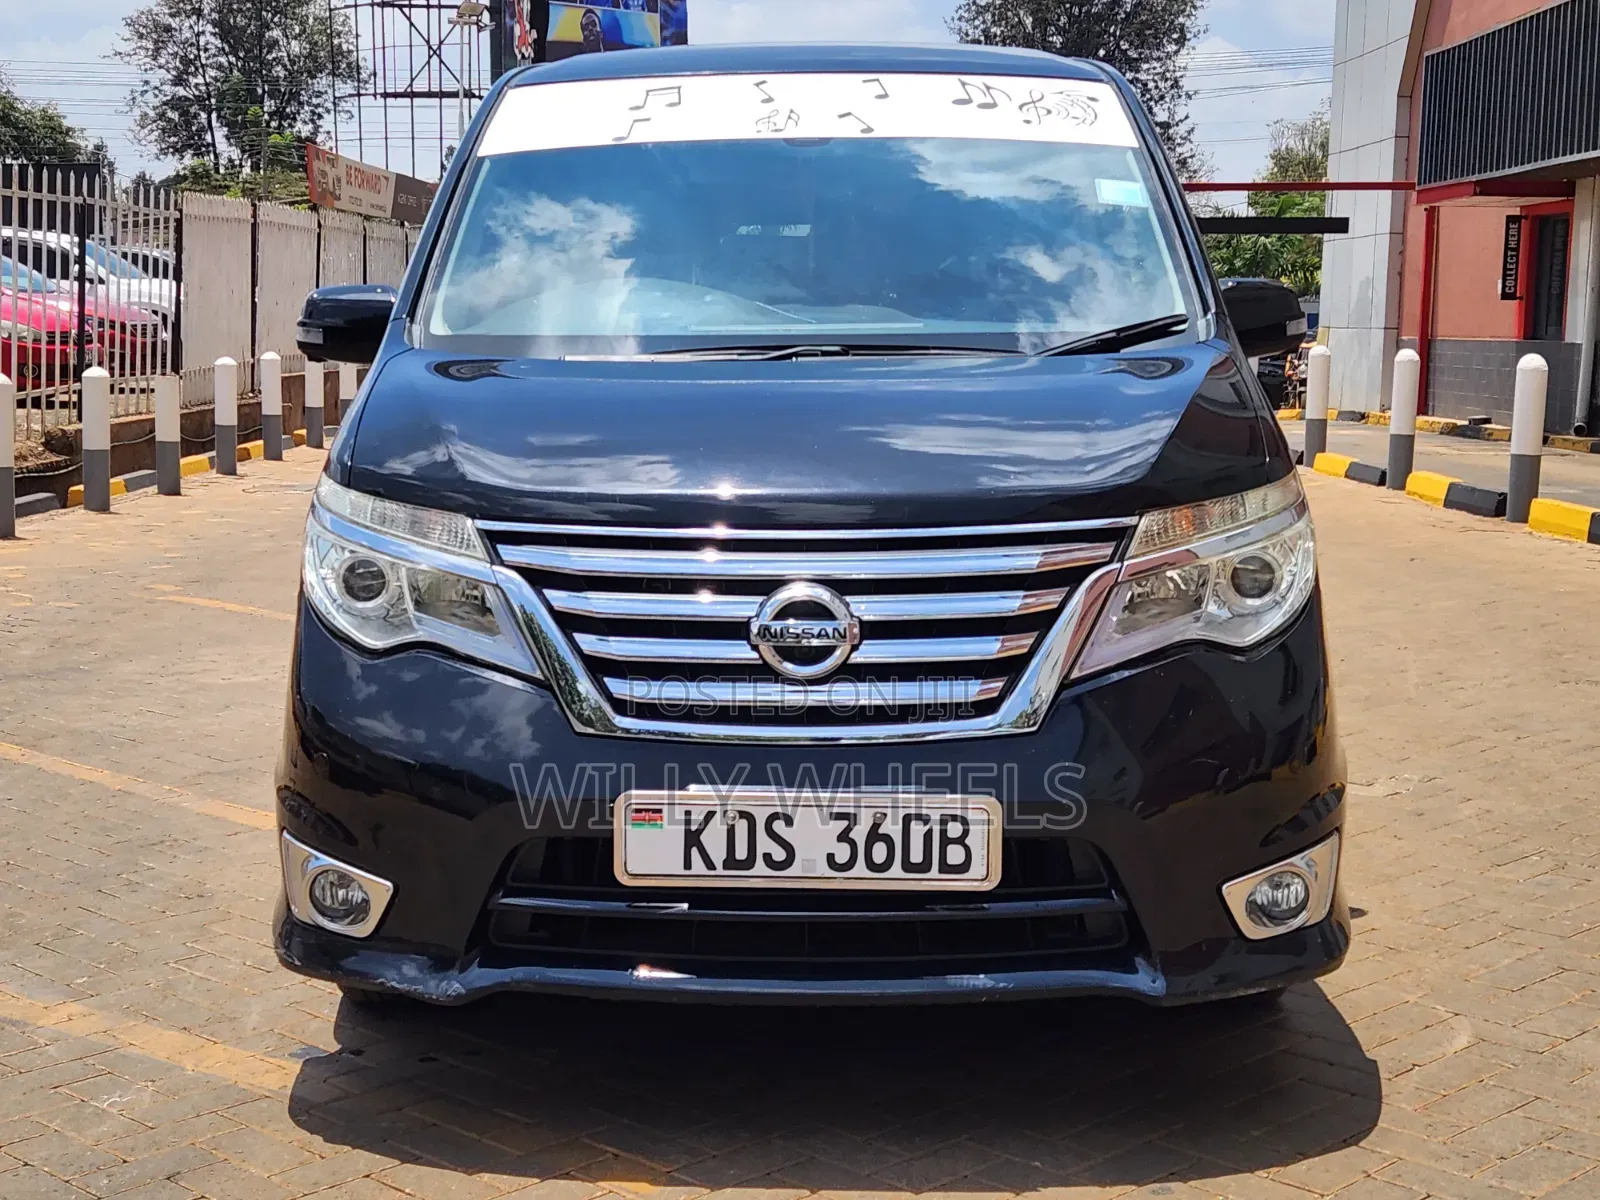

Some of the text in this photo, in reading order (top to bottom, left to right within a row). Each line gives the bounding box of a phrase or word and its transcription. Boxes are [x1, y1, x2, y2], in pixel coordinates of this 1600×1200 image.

[345, 164, 353, 187] BE
[354, 167, 382, 195] FORWARD
[1505, 222, 1519, 293] COLLECT HERE
[760, 625, 848, 641] NISSAN
[683, 810, 796, 871] KDS
[826, 811, 972, 875] 360B
